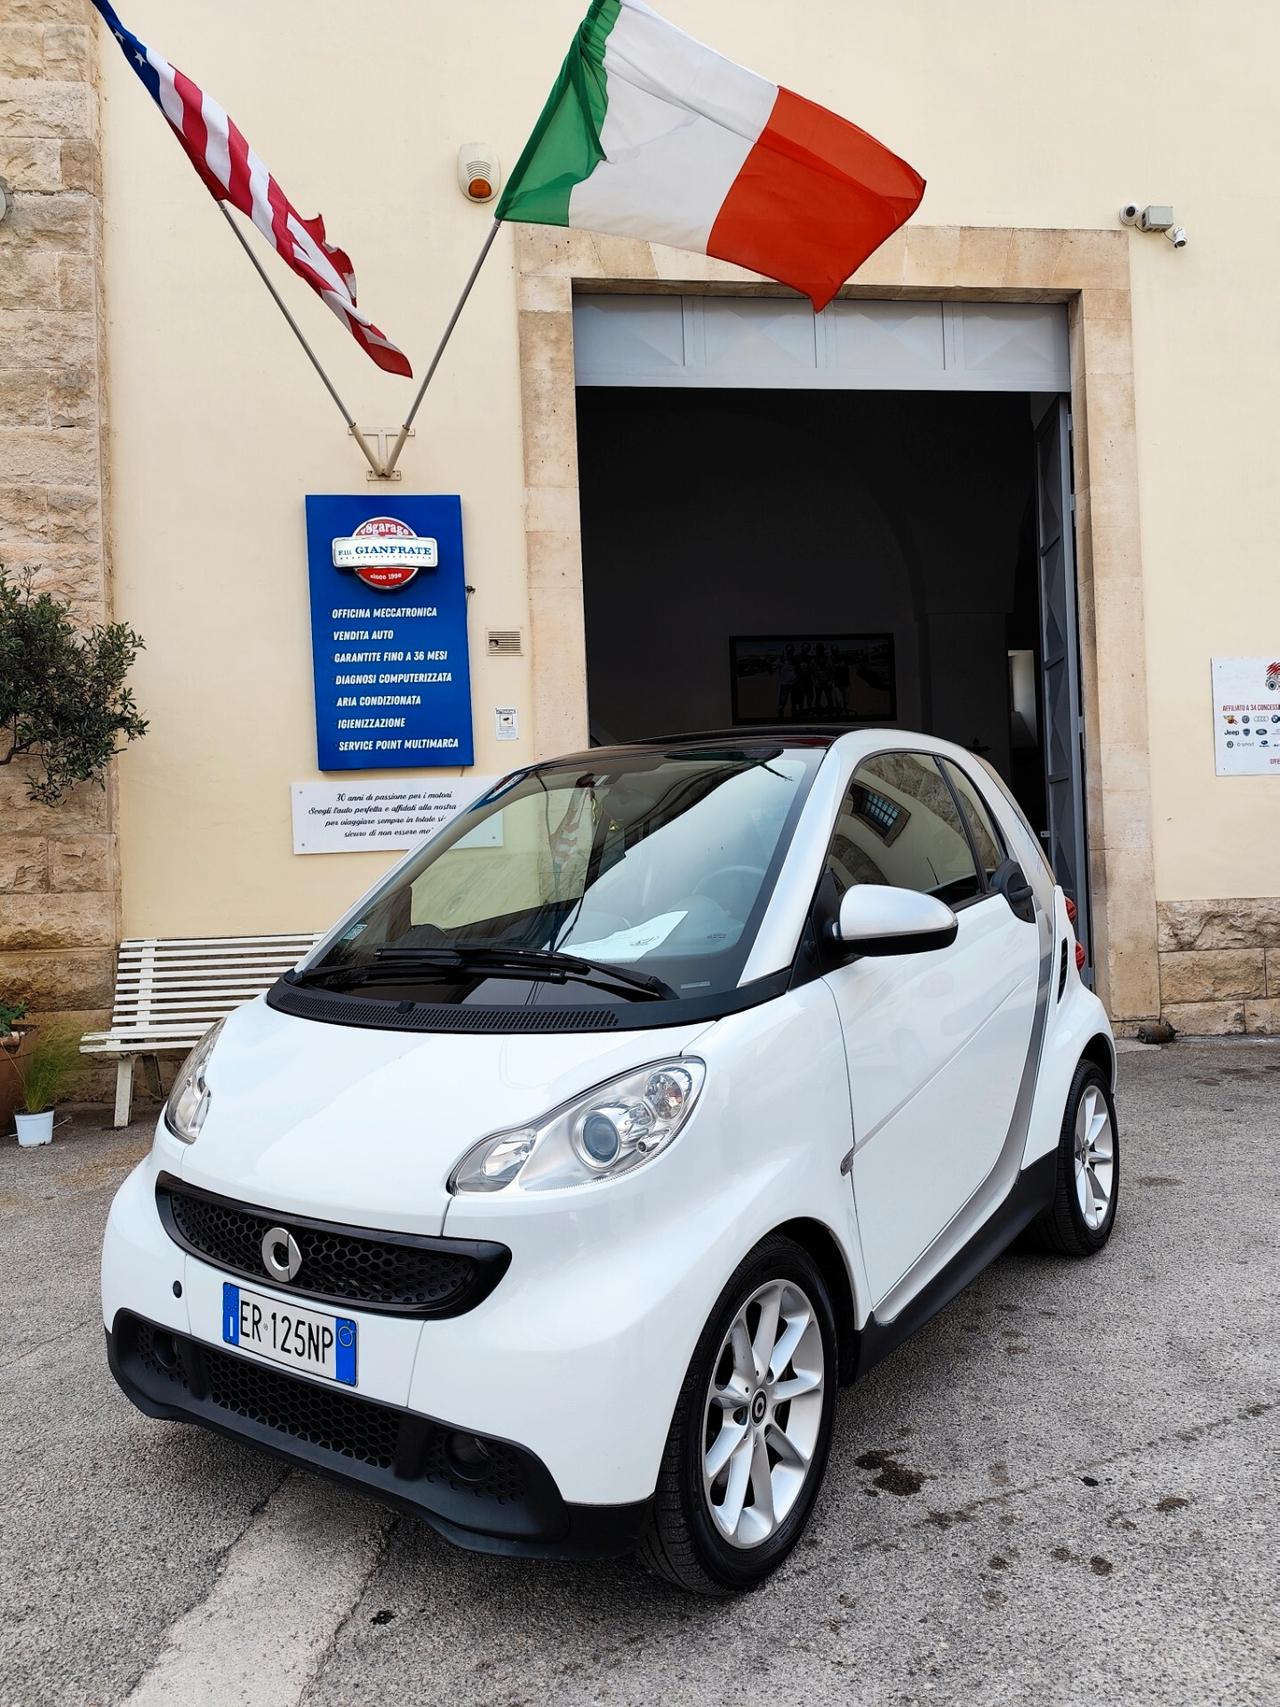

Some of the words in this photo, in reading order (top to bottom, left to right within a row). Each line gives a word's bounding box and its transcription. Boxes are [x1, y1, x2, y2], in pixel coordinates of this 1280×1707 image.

[355, 545, 432, 556] GIANFRATE
[332, 608, 371, 619] OFFICINA
[373, 607, 438, 618] MECCATRONICA
[333, 630, 369, 641] VENDITA
[371, 630, 394, 640] AUTO
[334, 652, 381, 663] GARANTITE
[383, 651, 404, 662] FINO
[405, 651, 412, 661] A
[413, 651, 425, 661] 36
[427, 650, 448, 661] MESI
[335, 674, 377, 685] DIAGNOSI
[378, 672, 453, 684] COMPUTERIZZATA
[336, 696, 358, 707] ARIA
[359, 695, 421, 706] CONDIZIONATA
[337, 717, 406, 729] IGIENIZZAZIONE
[338, 740, 374, 751] SERVICE
[375, 739, 402, 750] POINT
[404, 738, 459, 749] MULTIMARCA
[347, 794, 364, 802] anni
[374, 793, 407, 802] passione
[428, 791, 453, 799] motori
[308, 807, 332, 816] Scegli
[354, 805, 383, 815] perfetta
[391, 804, 417, 813] affidati
[433, 803, 457, 811] nostra
[324, 820, 339, 828] per
[340, 818, 376, 827] viaggiare
[406, 816, 414, 824] in
[414, 815, 436, 823] totale
[344, 830, 367, 838] sicuro
[368, 829, 377, 837] di
